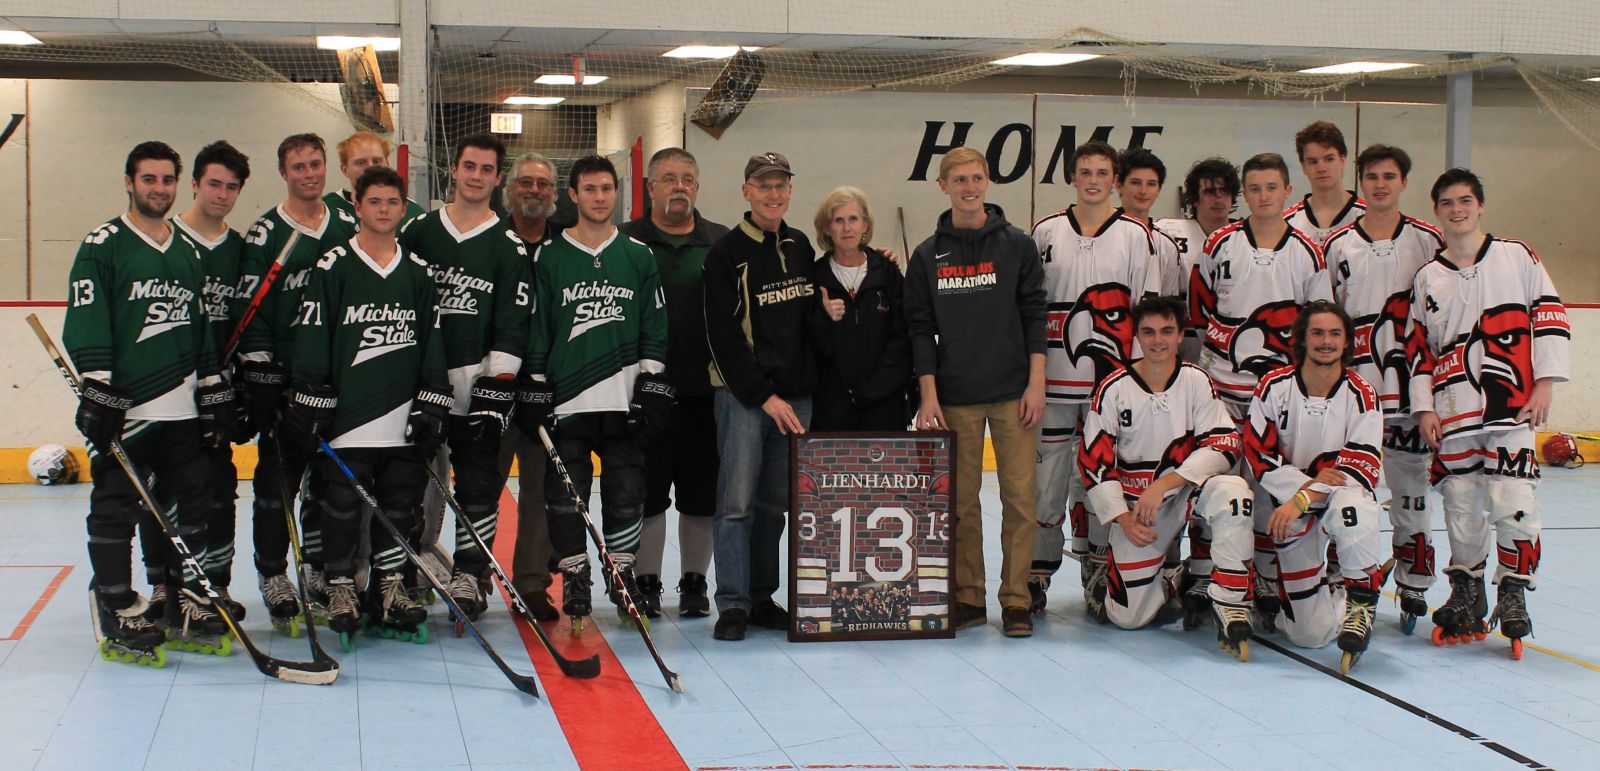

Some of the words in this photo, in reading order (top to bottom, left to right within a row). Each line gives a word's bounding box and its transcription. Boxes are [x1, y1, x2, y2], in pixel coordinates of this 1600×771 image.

[497, 115, 517, 131] EXIT
[434, 264, 494, 295] chigan
[937, 272, 997, 290] MARATHON
[72, 279, 95, 308] 13
[515, 281, 529, 306] 5
[561, 279, 635, 307] Michigan
[301, 300, 323, 326] 71
[342, 302, 417, 329] Michiga
[572, 300, 626, 325] State
[359, 325, 417, 348] State
[83, 387, 134, 410] BAUE
[295, 392, 338, 409] WARRIO
[417, 390, 455, 408] WARR
[1118, 408, 1133, 428] 9
[821, 474, 931, 489] LIENHARDT
[1229, 497, 1253, 516] 19
[1401, 495, 1425, 511] 10
[1341, 505, 1358, 527] 9
[831, 507, 918, 582] 13
[848, 621, 908, 632] REDHAWKS
